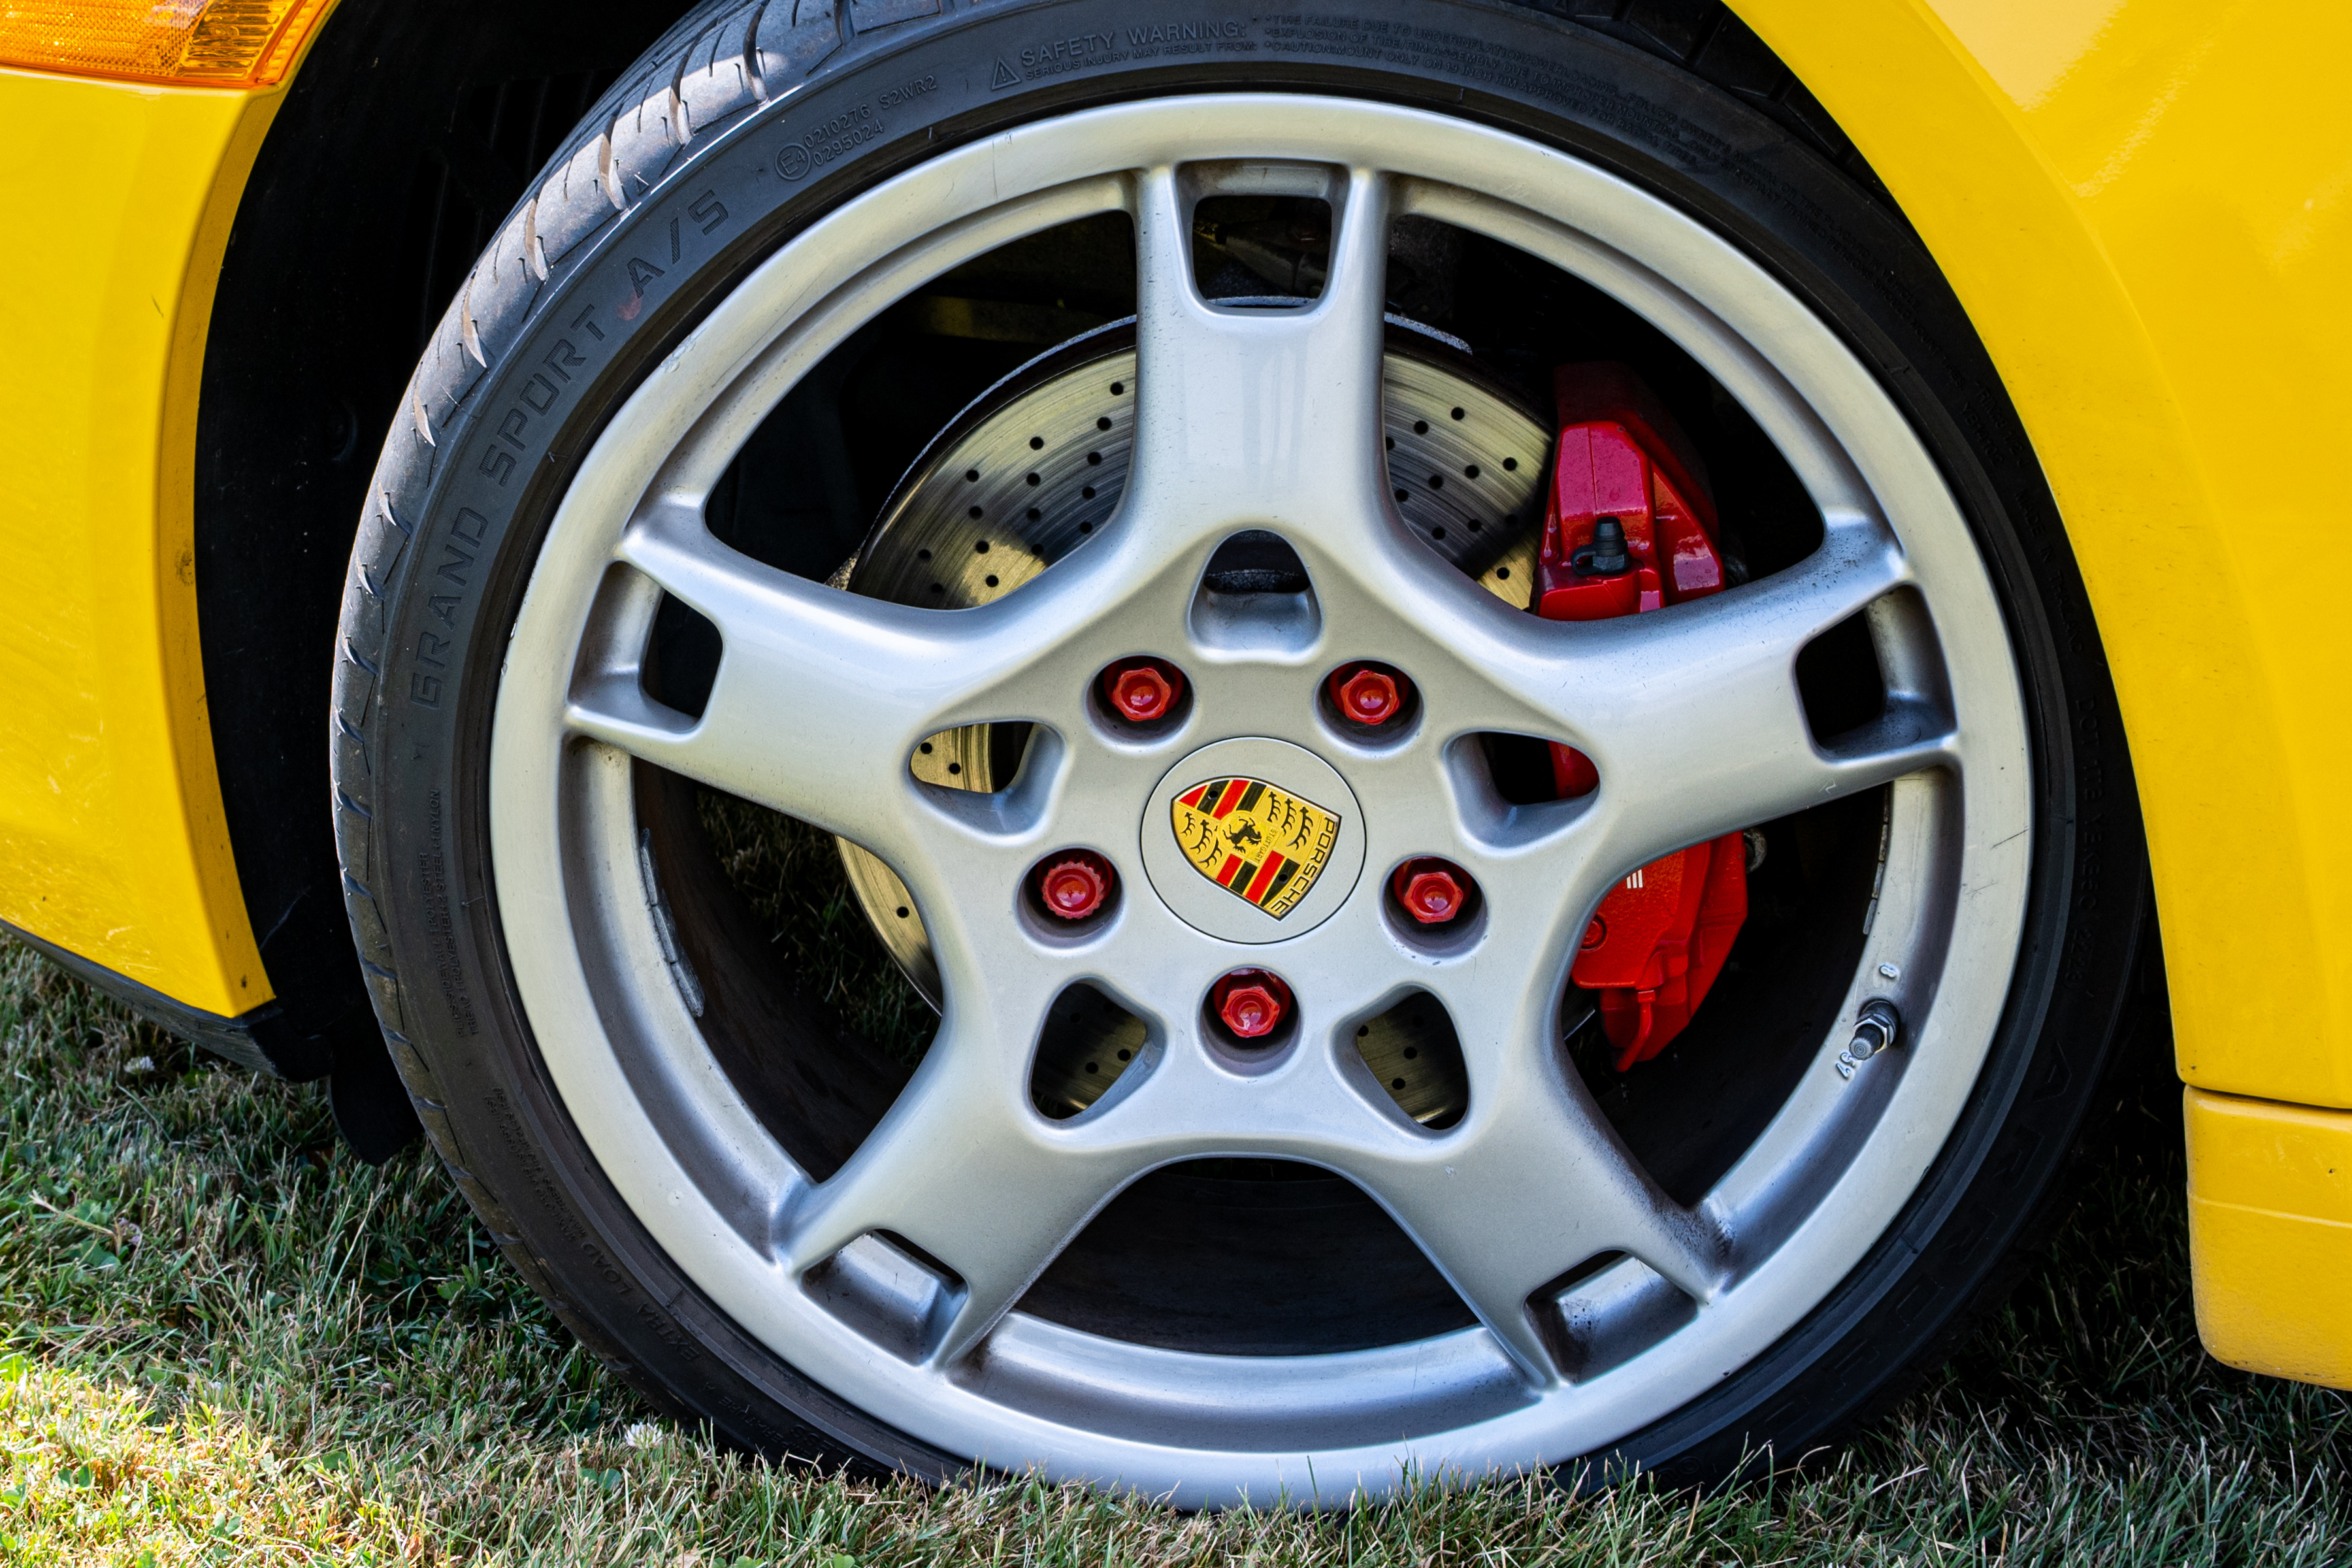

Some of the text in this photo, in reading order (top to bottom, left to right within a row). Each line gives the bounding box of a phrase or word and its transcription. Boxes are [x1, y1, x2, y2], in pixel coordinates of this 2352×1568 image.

[1018, 19, 1247, 67] SAFETY WARNING:
[1024, 41, 1257, 81] SERIOUS INJURY MAY RESULT FROM:
[800, 74, 939, 149] 0210276 S2WR2
[1304, 14, 1358, 29] FAILURE
[1360, 20, 1390, 33] DUE
[1392, 24, 1411, 37] TO
[1730, 149, 1781, 187] MANUAL
[1348, 31, 1367, 44] OF
[1371, 33, 1429, 54] TIRE/RIM
[1430, 44, 1501, 70] ASSEMBLY
[1501, 61, 1529, 78] DUE
[1531, 70, 1551, 86] TO
[1551, 77, 1616, 111] IMPROPER
[1777, 197, 1829, 240] TRAINED
[1384, 50, 1420, 66] ONLY
[1422, 56, 1443, 71] ON
[1444, 61, 1460, 74] 19
[1460, 64, 1493, 82] INCH
[1494, 73, 1518, 90] RIM
[1518, 80, 1588, 114] APPROVED
[1587, 106, 1616, 126] FOR
[1614, 118, 1662, 148] RADIAL
[809, 118, 886, 167] 0295024
[406, 189, 730, 710] GRAND SPORT A/S
[2012, 487, 2047, 538] MADE
[1254, 828, 1278, 863] STUTTGART
[1270, 817, 1336, 915] PORSCHE
[417, 851, 438, 926] POLYESTER
[578, 1236, 700, 1364] EXTRA LOAD
